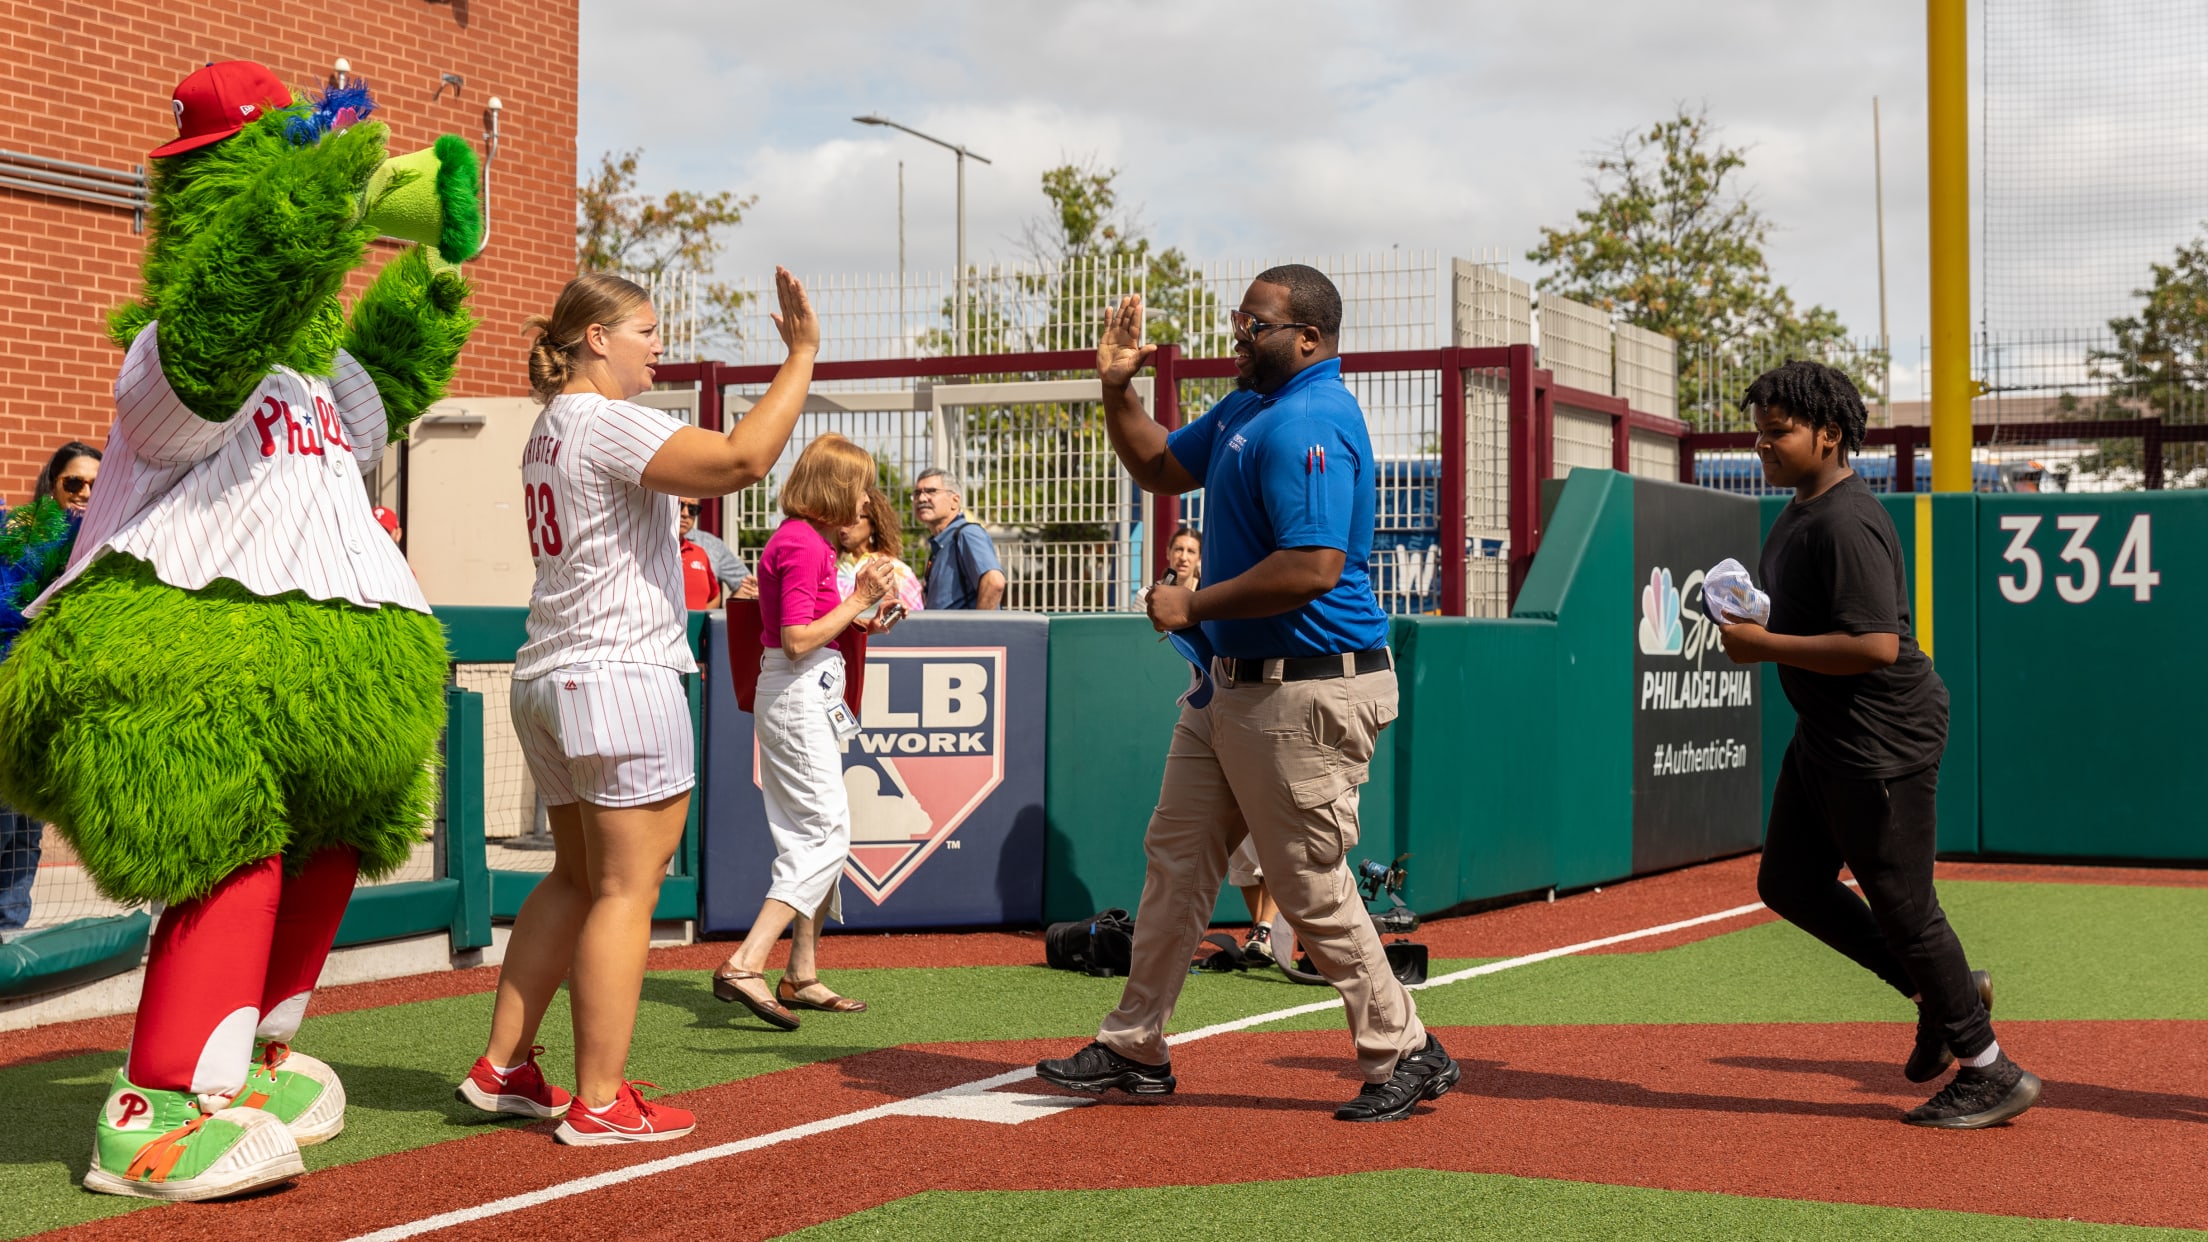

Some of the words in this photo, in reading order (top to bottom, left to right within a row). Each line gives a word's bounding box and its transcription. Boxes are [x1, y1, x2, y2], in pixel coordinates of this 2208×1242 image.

[172, 99, 184, 129] P
[253, 396, 353, 457] Phill
[522, 435, 562, 467] RISTEN
[525, 482, 563, 557] 23
[1998, 513, 2161, 604] 334
[861, 663, 988, 729] LB
[1641, 670, 1752, 710] PHILADELPHIA
[1653, 738, 1747, 777] #AuthenticFan
[945, 840, 961, 850] TM
[116, 1092, 149, 1128] P
